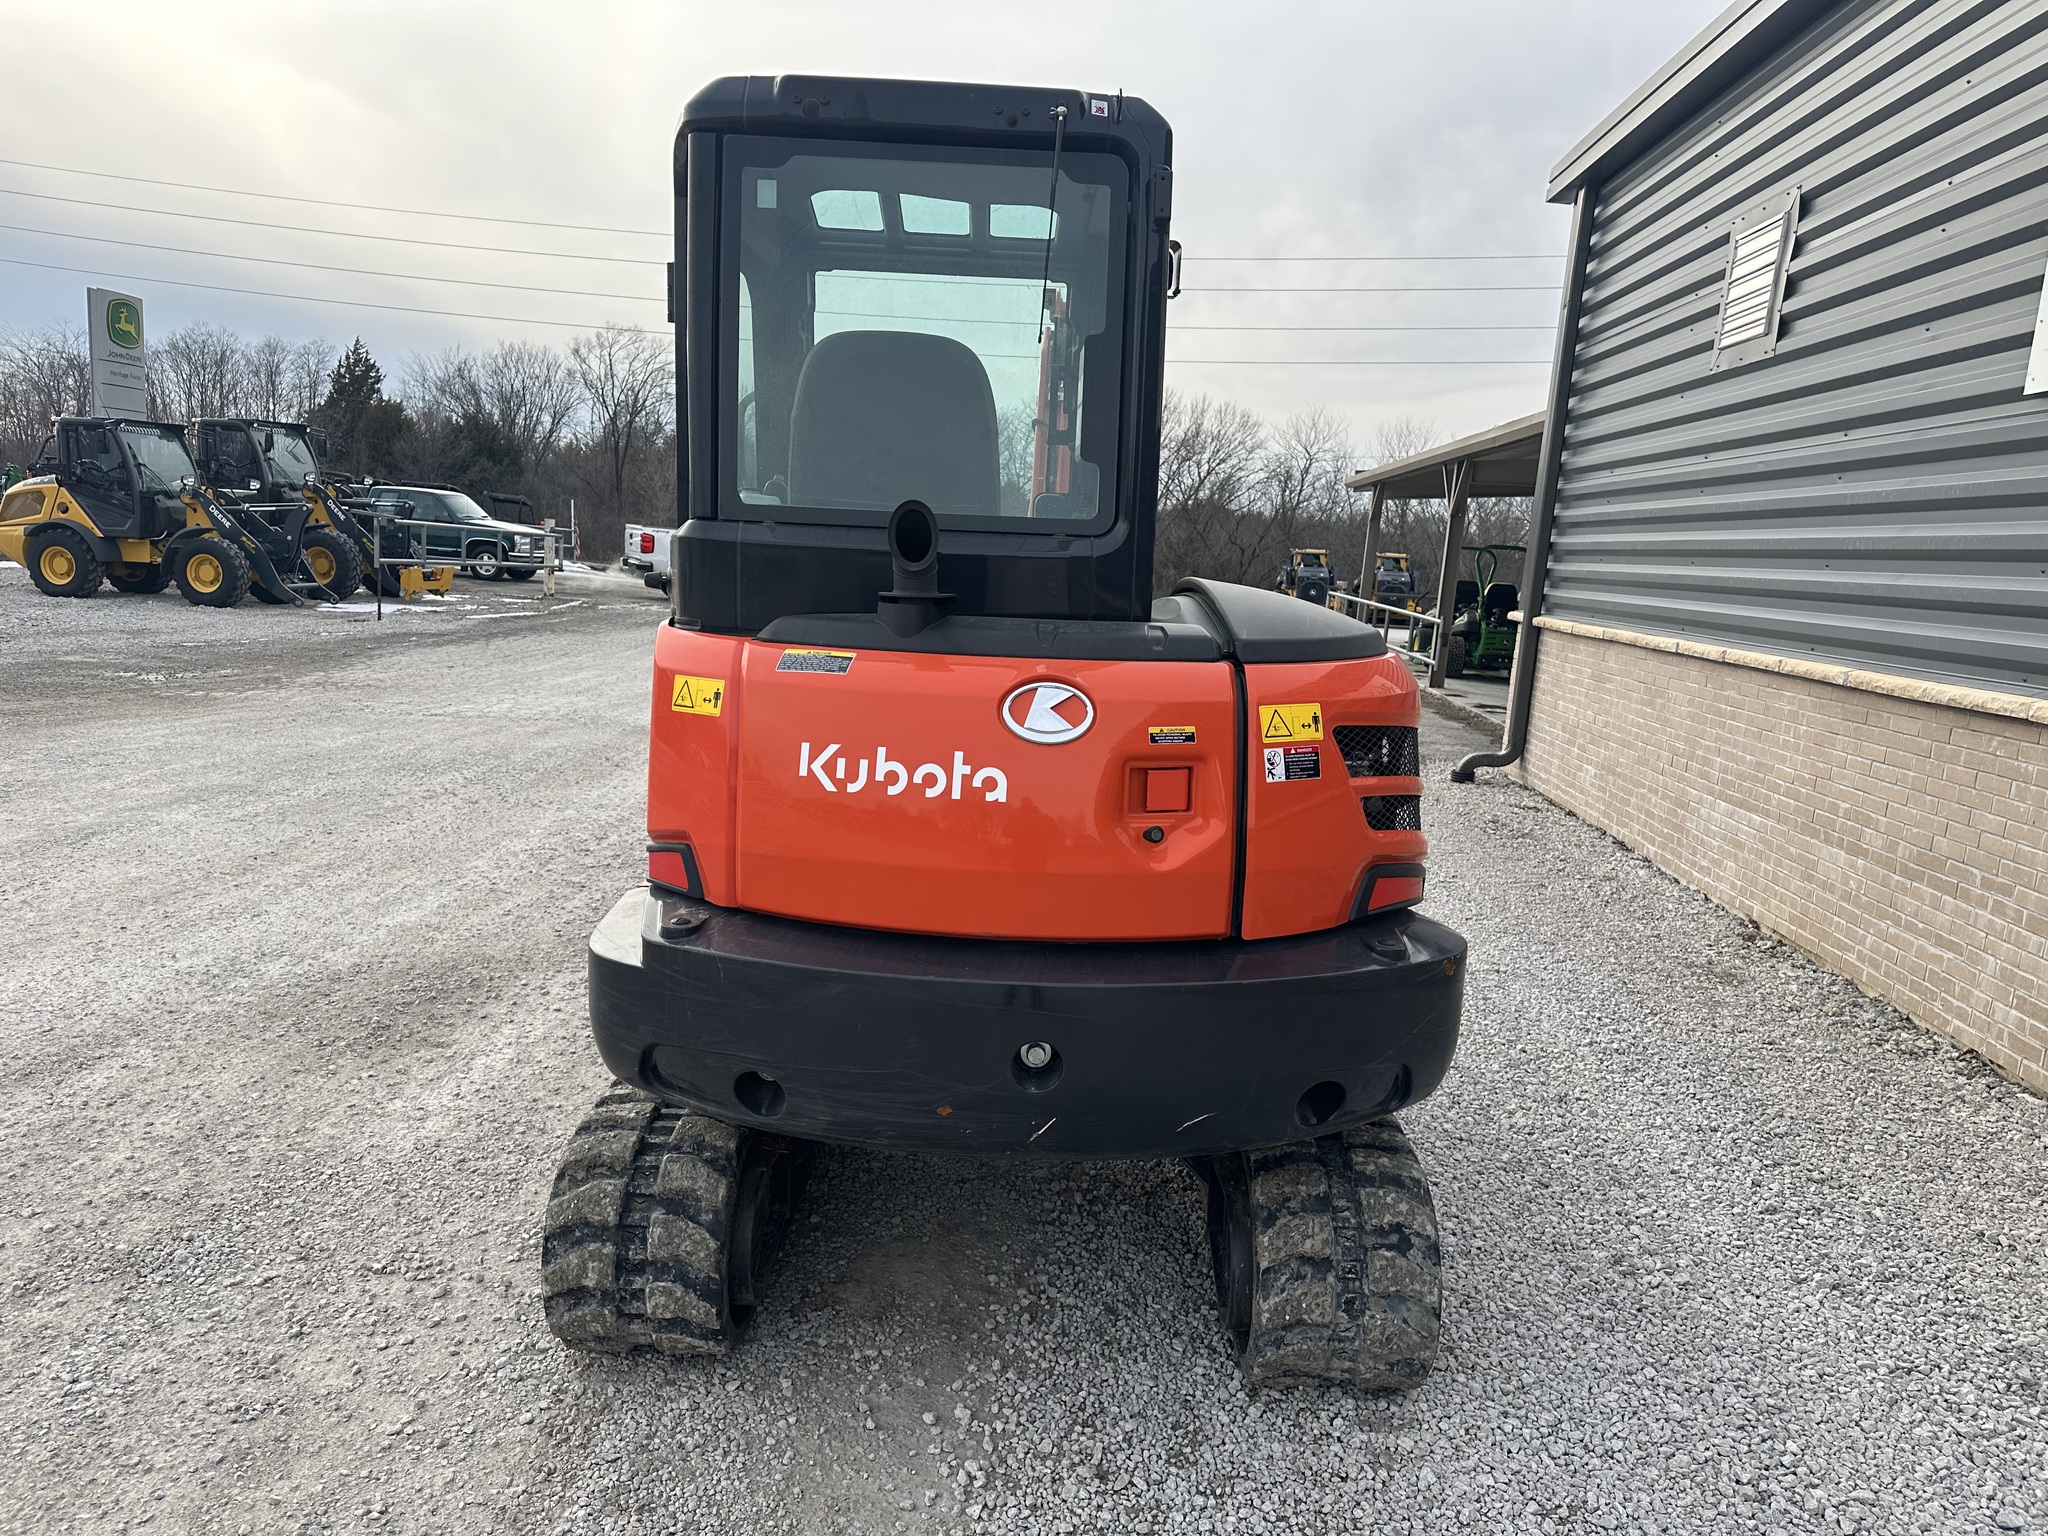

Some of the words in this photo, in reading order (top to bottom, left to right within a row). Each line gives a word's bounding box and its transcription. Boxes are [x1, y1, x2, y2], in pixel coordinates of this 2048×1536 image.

[209, 504, 231, 529] DEERE
[327, 499, 346, 521] DEERE
[798, 742, 1008, 803] Kubota
